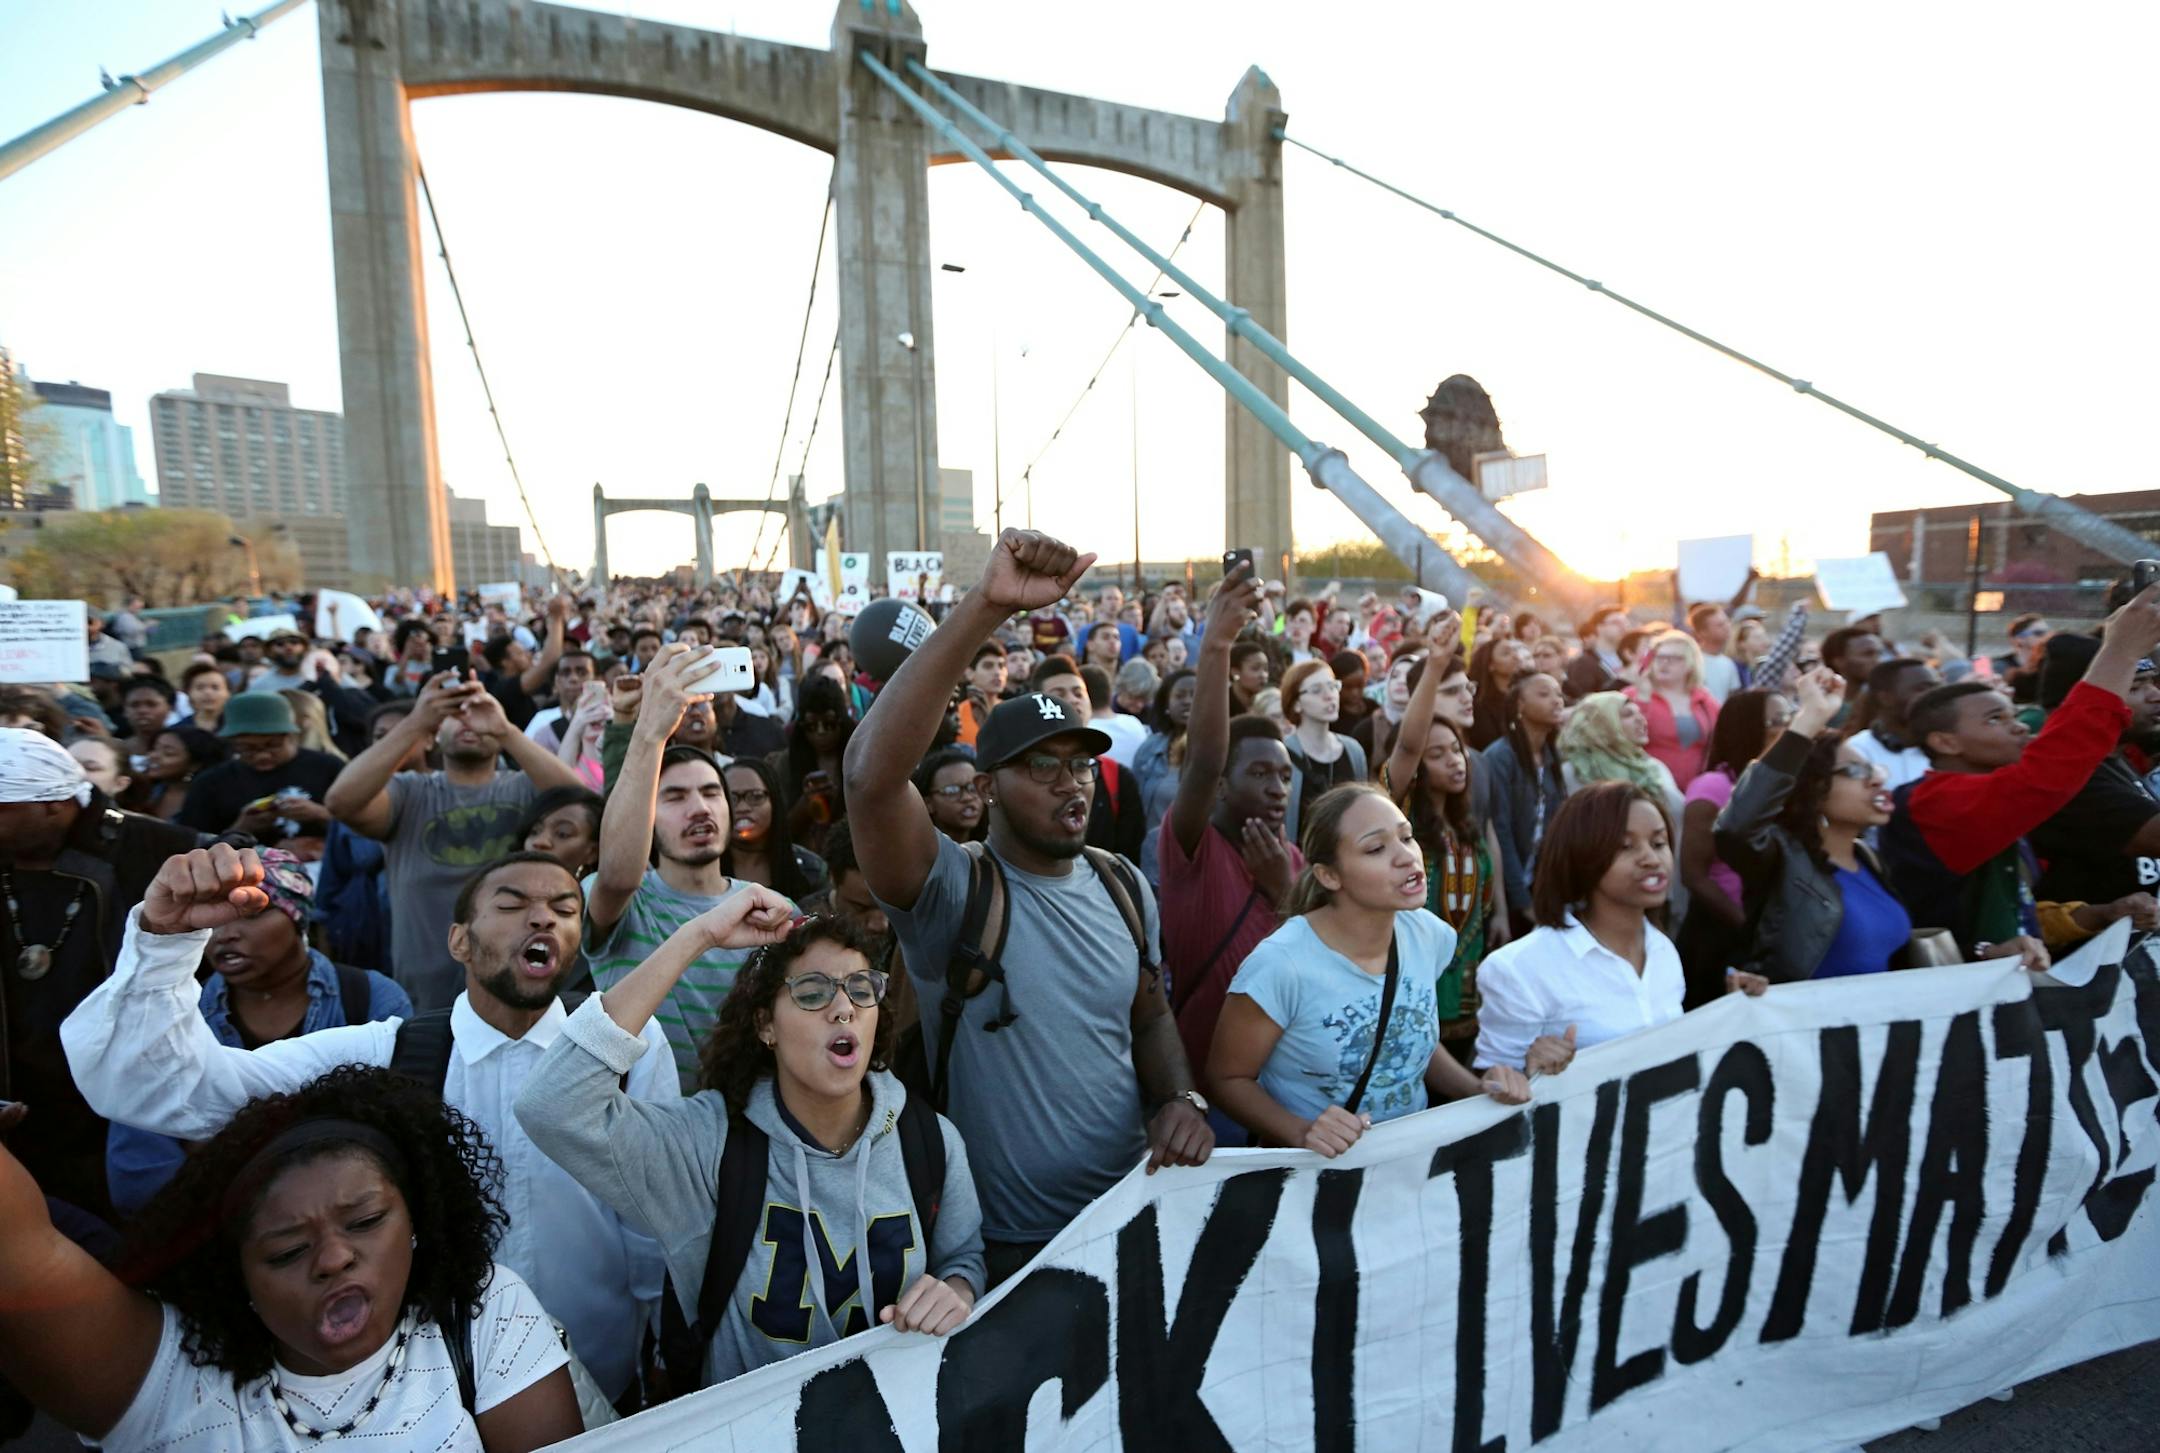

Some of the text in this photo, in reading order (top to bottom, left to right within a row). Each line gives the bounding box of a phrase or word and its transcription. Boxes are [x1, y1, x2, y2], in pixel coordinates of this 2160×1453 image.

[905, 615, 929, 649] LIVES
[1031, 693, 1066, 720] LA
[750, 1202, 916, 1345] M
